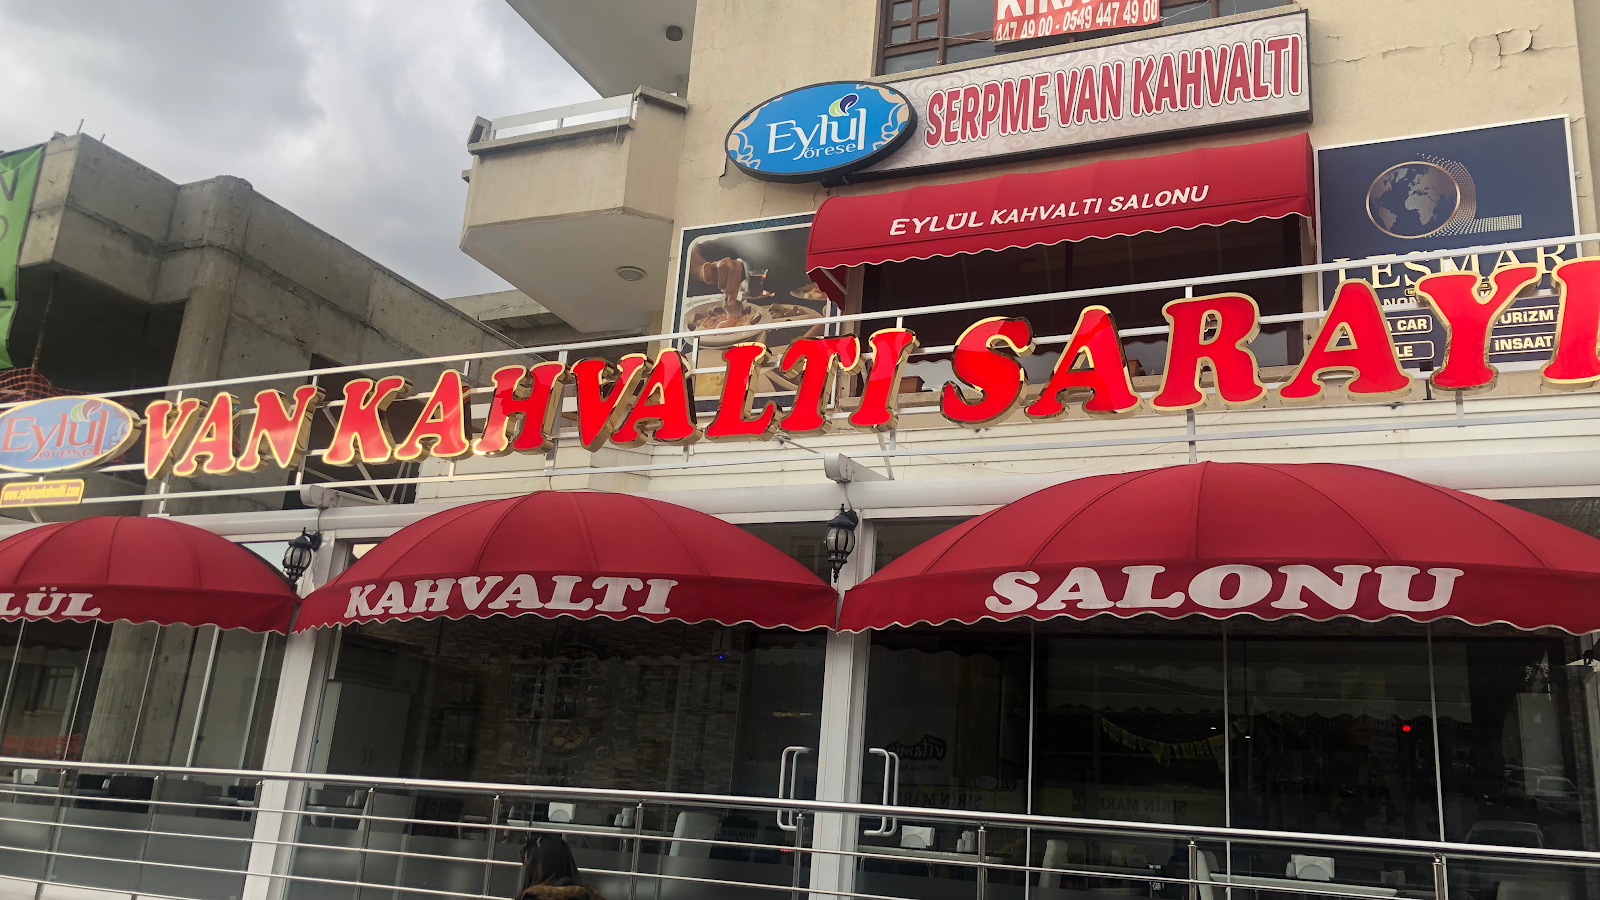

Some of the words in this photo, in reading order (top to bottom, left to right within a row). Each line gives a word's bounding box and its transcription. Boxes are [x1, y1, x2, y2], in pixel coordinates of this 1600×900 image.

[996, 20, 1017, 40] 447
[1020, 19, 1036, 39] 49
[1038, 15, 1053, 37] 00
[1062, 5, 1093, 31] 0549
[1095, 2, 1120, 26] 447
[1122, 0, 1139, 24] 49
[1142, 0, 1158, 22] 00
[925, 76, 1049, 148] SERPME
[1055, 64, 1124, 127] VAN
[1132, 34, 1303, 115] KAHVALTI
[890, 207, 985, 237] EYLÜL
[990, 197, 1104, 225] KAHVALTI
[1108, 184, 1210, 211] SALONU
[1397, 318, 1428, 332] CAR
[145, 385, 324, 479] VAN
[322, 328, 918, 466] KAHVALTI
[344, 574, 678, 618] KAHVALTI
[985, 564, 1465, 613] SALONU
